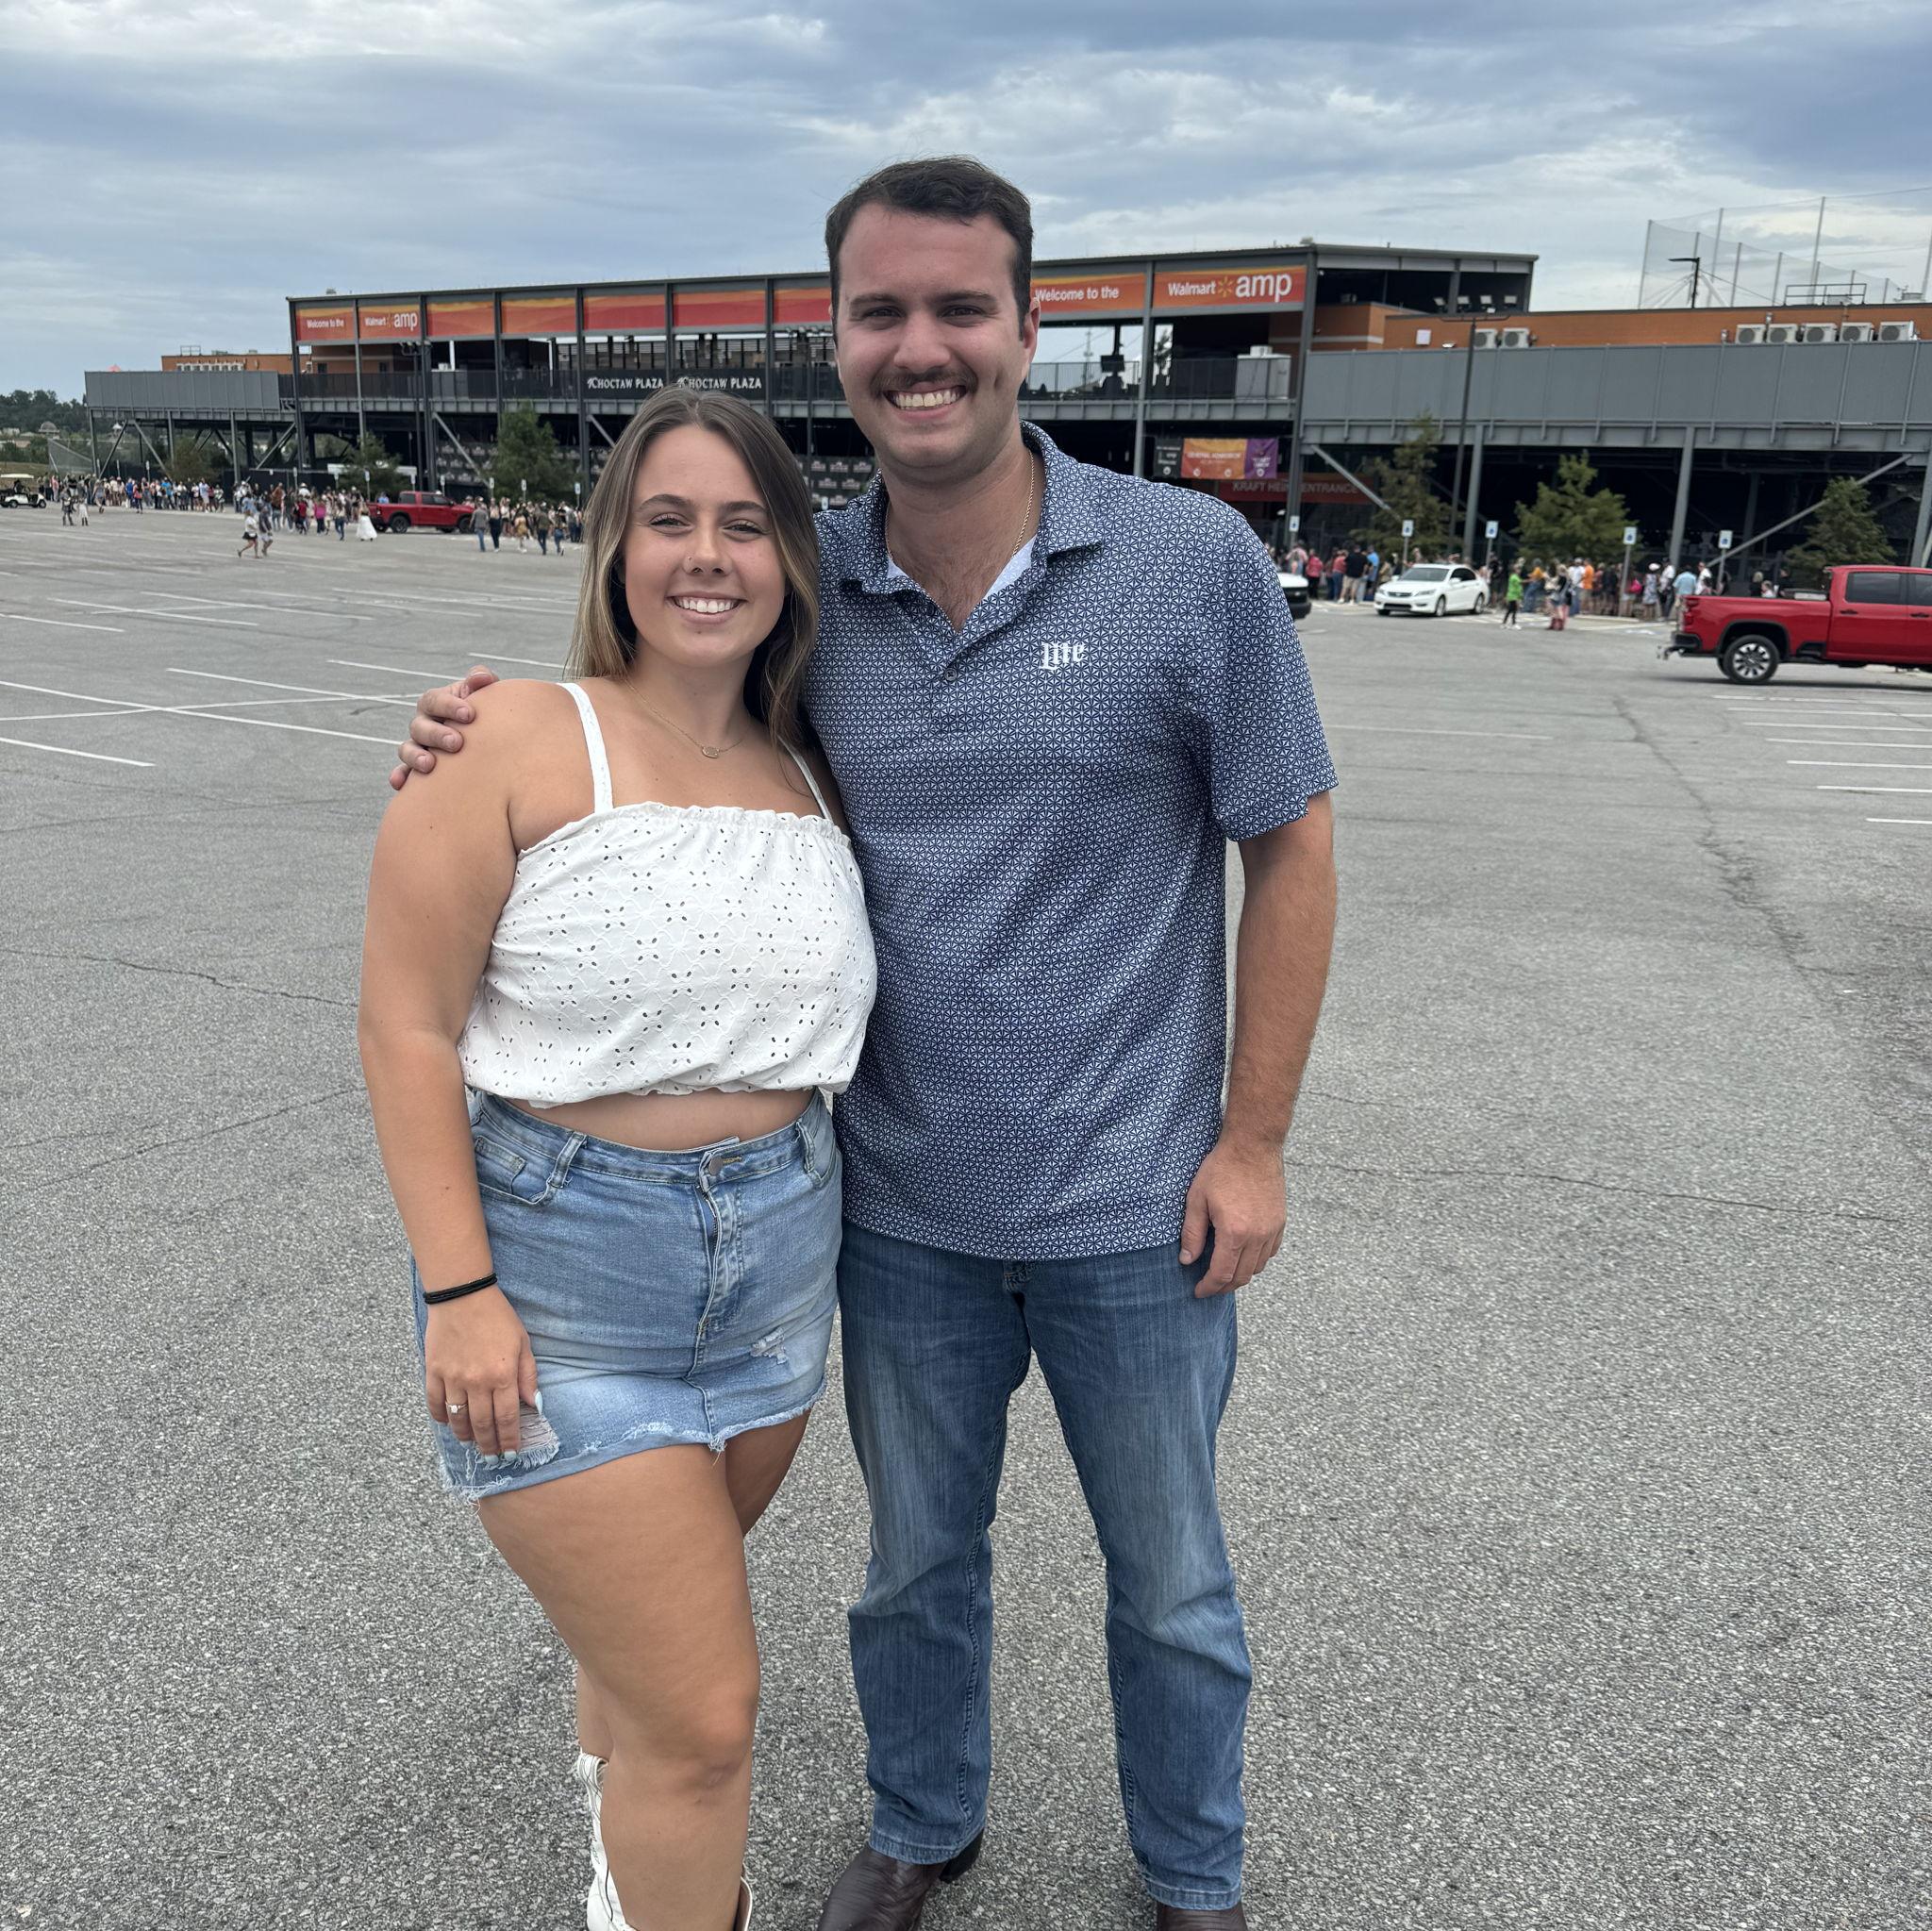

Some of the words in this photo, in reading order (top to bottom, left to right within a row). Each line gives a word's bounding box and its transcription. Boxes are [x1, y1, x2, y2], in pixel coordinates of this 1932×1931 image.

[1035, 288, 1084, 302] Welcome
[1086, 287, 1099, 299] to
[1101, 285, 1120, 299] the
[1168, 281, 1216, 296] Walmart
[1235, 273, 1293, 303] amp
[307, 319, 329, 328] Welcome
[364, 316, 387, 326] Walmart
[393, 312, 418, 331] amp
[591, 376, 633, 389] CHOCTAW
[635, 377, 663, 389] PLAZA
[730, 377, 761, 389] PLAZA
[1232, 481, 1265, 491] KRAFT
[1301, 482, 1358, 493] ENTRANCE
